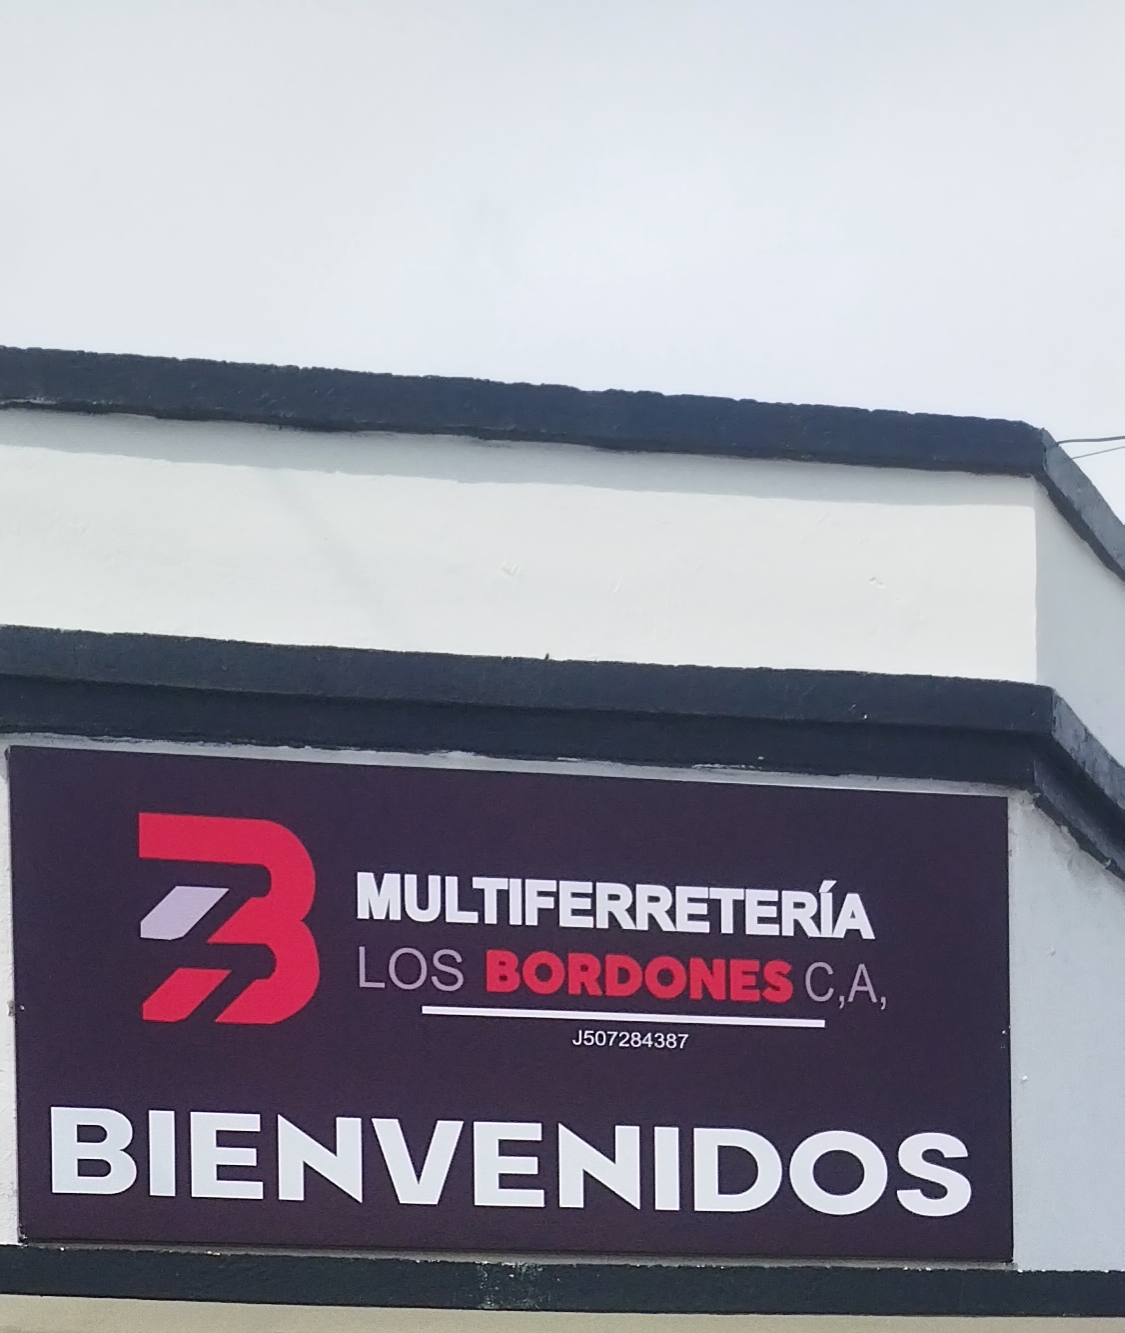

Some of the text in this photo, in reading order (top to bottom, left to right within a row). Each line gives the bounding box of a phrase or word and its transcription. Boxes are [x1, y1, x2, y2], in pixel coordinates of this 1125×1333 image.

[356, 871, 876, 940] MULTIFERRETERÍA
[358, 946, 464, 992] LOS
[485, 949, 794, 1004] BORDONES
[571, 1029, 690, 1049] J507284387
[50, 1106, 972, 1217] BIENVENIDOS
